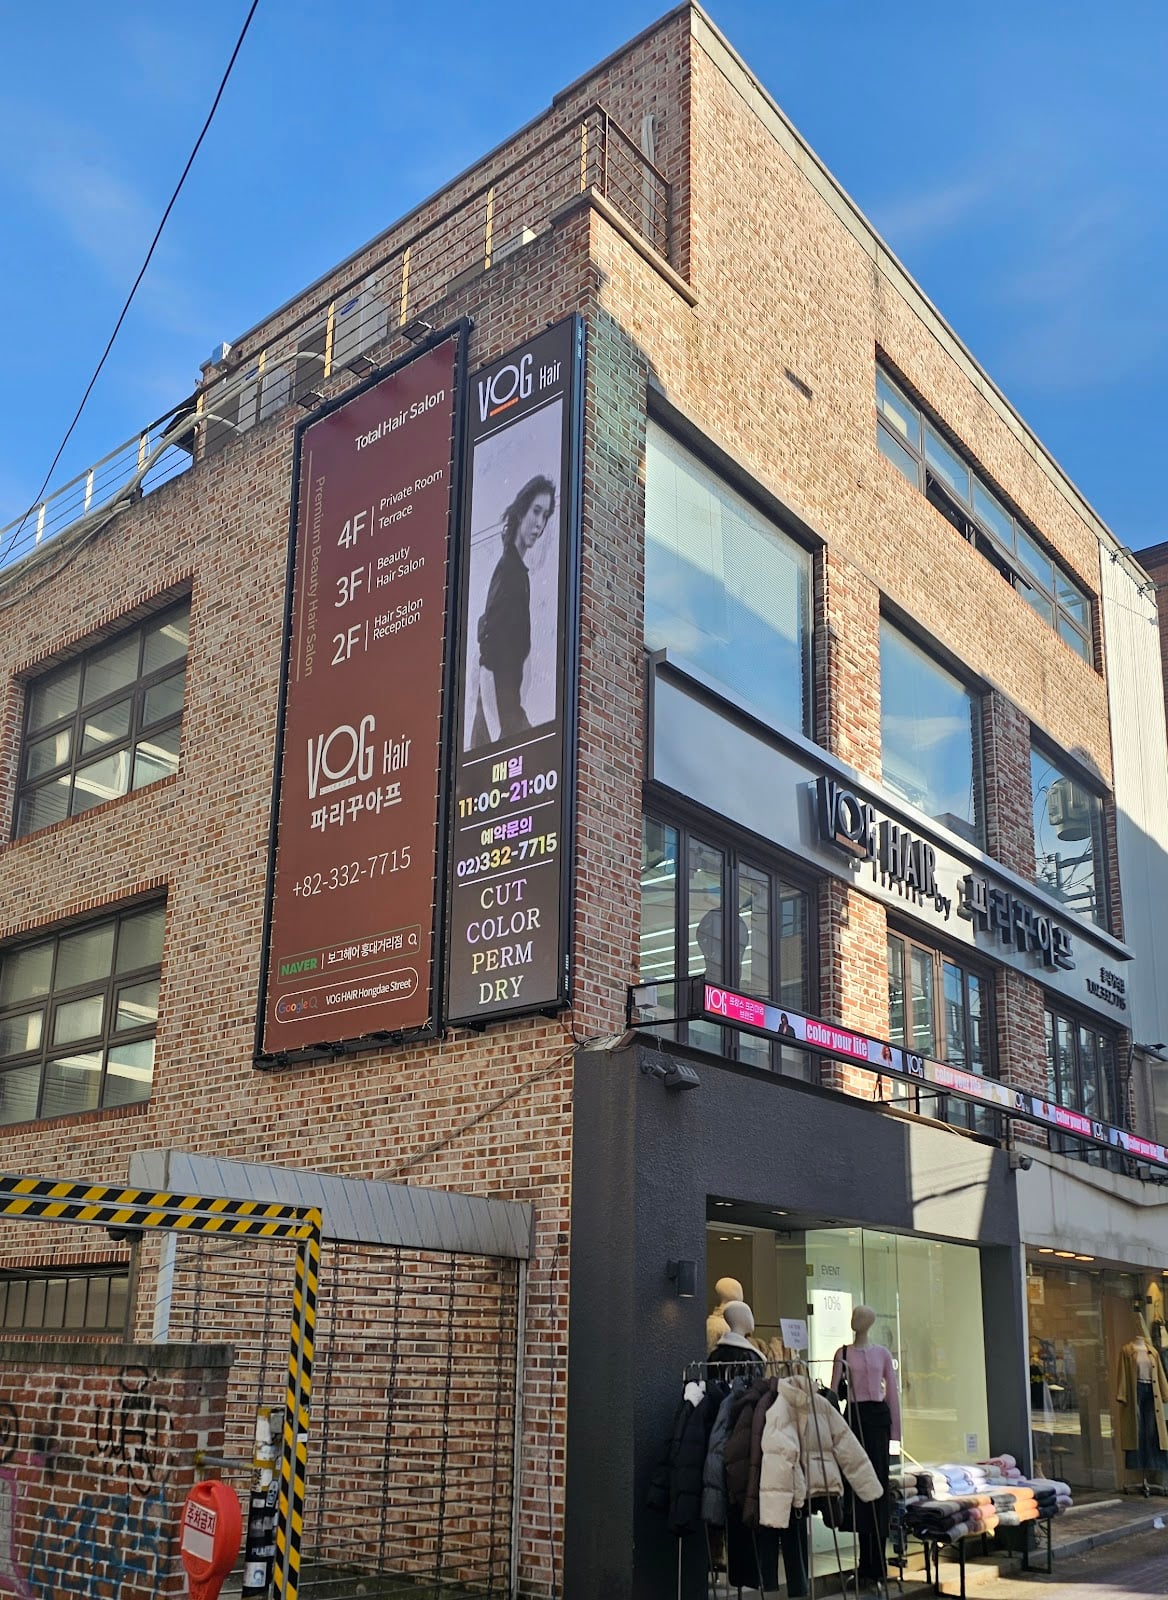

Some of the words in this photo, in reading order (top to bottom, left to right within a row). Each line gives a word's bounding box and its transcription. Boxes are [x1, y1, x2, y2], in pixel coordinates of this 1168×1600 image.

[478, 353, 533, 422] VOG
[540, 360, 561, 390] Hair
[355, 423, 381, 450] Total
[383, 411, 408, 435] Hair
[410, 389, 445, 419] Salon
[380, 486, 412, 510] Private
[414, 469, 443, 492] Room
[313, 476, 325, 544] Premium
[379, 505, 413, 528] Terrace
[337, 510, 367, 549] 4F
[307, 546, 322, 598] Beauty
[376, 570, 396, 588] Hair
[398, 557, 425, 577] Salon
[377, 546, 410, 570] Beauty
[335, 566, 365, 608] 3F
[307, 600, 319, 632] Hair
[373, 611, 421, 640] Reception
[374, 611, 394, 628] Hair
[396, 598, 423, 618] Salon
[304, 633, 317, 678] Salon
[331, 623, 361, 665] 2F
[308, 714, 375, 799] VOG
[383, 734, 411, 775] Hair
[492, 756, 523, 783] 매일
[310, 782, 402, 832] 파리꾸아프
[459, 770, 558, 818] 11:00~21:00
[481, 816, 533, 846] 예약문의
[457, 832, 557, 877] 02)332-7715
[816, 775, 878, 863] VOG
[879, 820, 938, 898] HAIR
[935, 893, 951, 921] by
[293, 846, 411, 897] +82-332-7715
[481, 879, 527, 909] CUT
[466, 908, 541, 943] COLOR
[327, 945, 360, 964] 보그헤어
[361, 934, 403, 957] 홍대거리점
[471, 941, 533, 974] PERM
[281, 958, 318, 976] NAVER
[326, 994, 341, 1005] VOG
[341, 991, 359, 1003] HAIR
[359, 984, 390, 998] Hongdae
[390, 978, 412, 991] Street
[479, 975, 524, 1004] DRY
[705, 986, 727, 1016] VOG
[279, 998, 309, 1014] Google
[807, 1024, 831, 1045] color
[832, 1032, 852, 1052] your
[853, 1037, 868, 1057] life
[821, 1265, 840, 1276] EVENT
[823, 1296, 841, 1311] 10%
[187, 1507, 216, 1533] 주차금지
